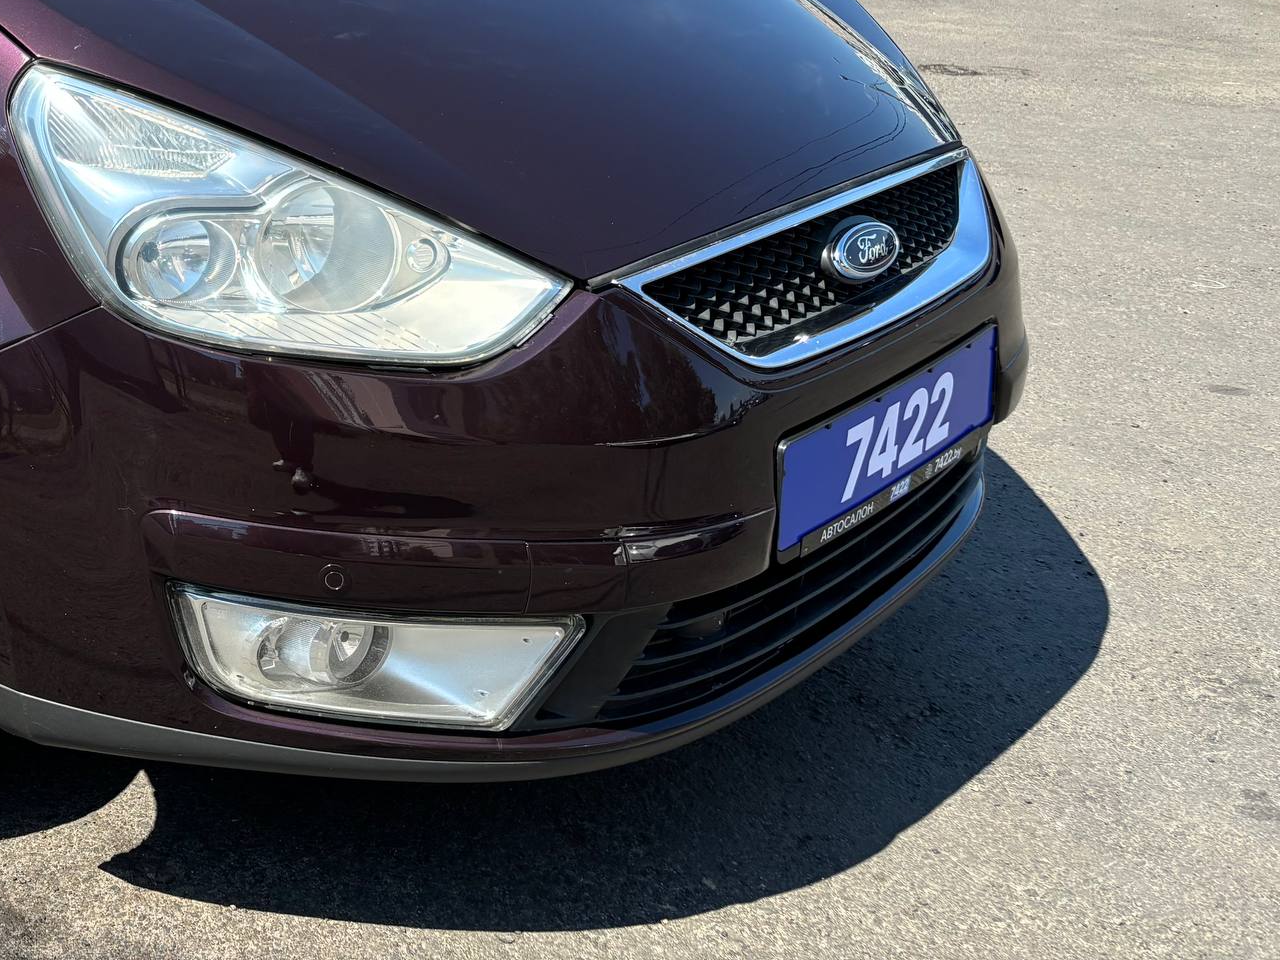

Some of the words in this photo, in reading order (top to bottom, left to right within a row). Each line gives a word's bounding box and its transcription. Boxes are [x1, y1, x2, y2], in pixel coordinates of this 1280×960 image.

[857, 233, 889, 264] Ford
[840, 371, 955, 504] 7422
[934, 447, 962, 472] 7422.by
[820, 501, 875, 542] АВТОСАЛОН
